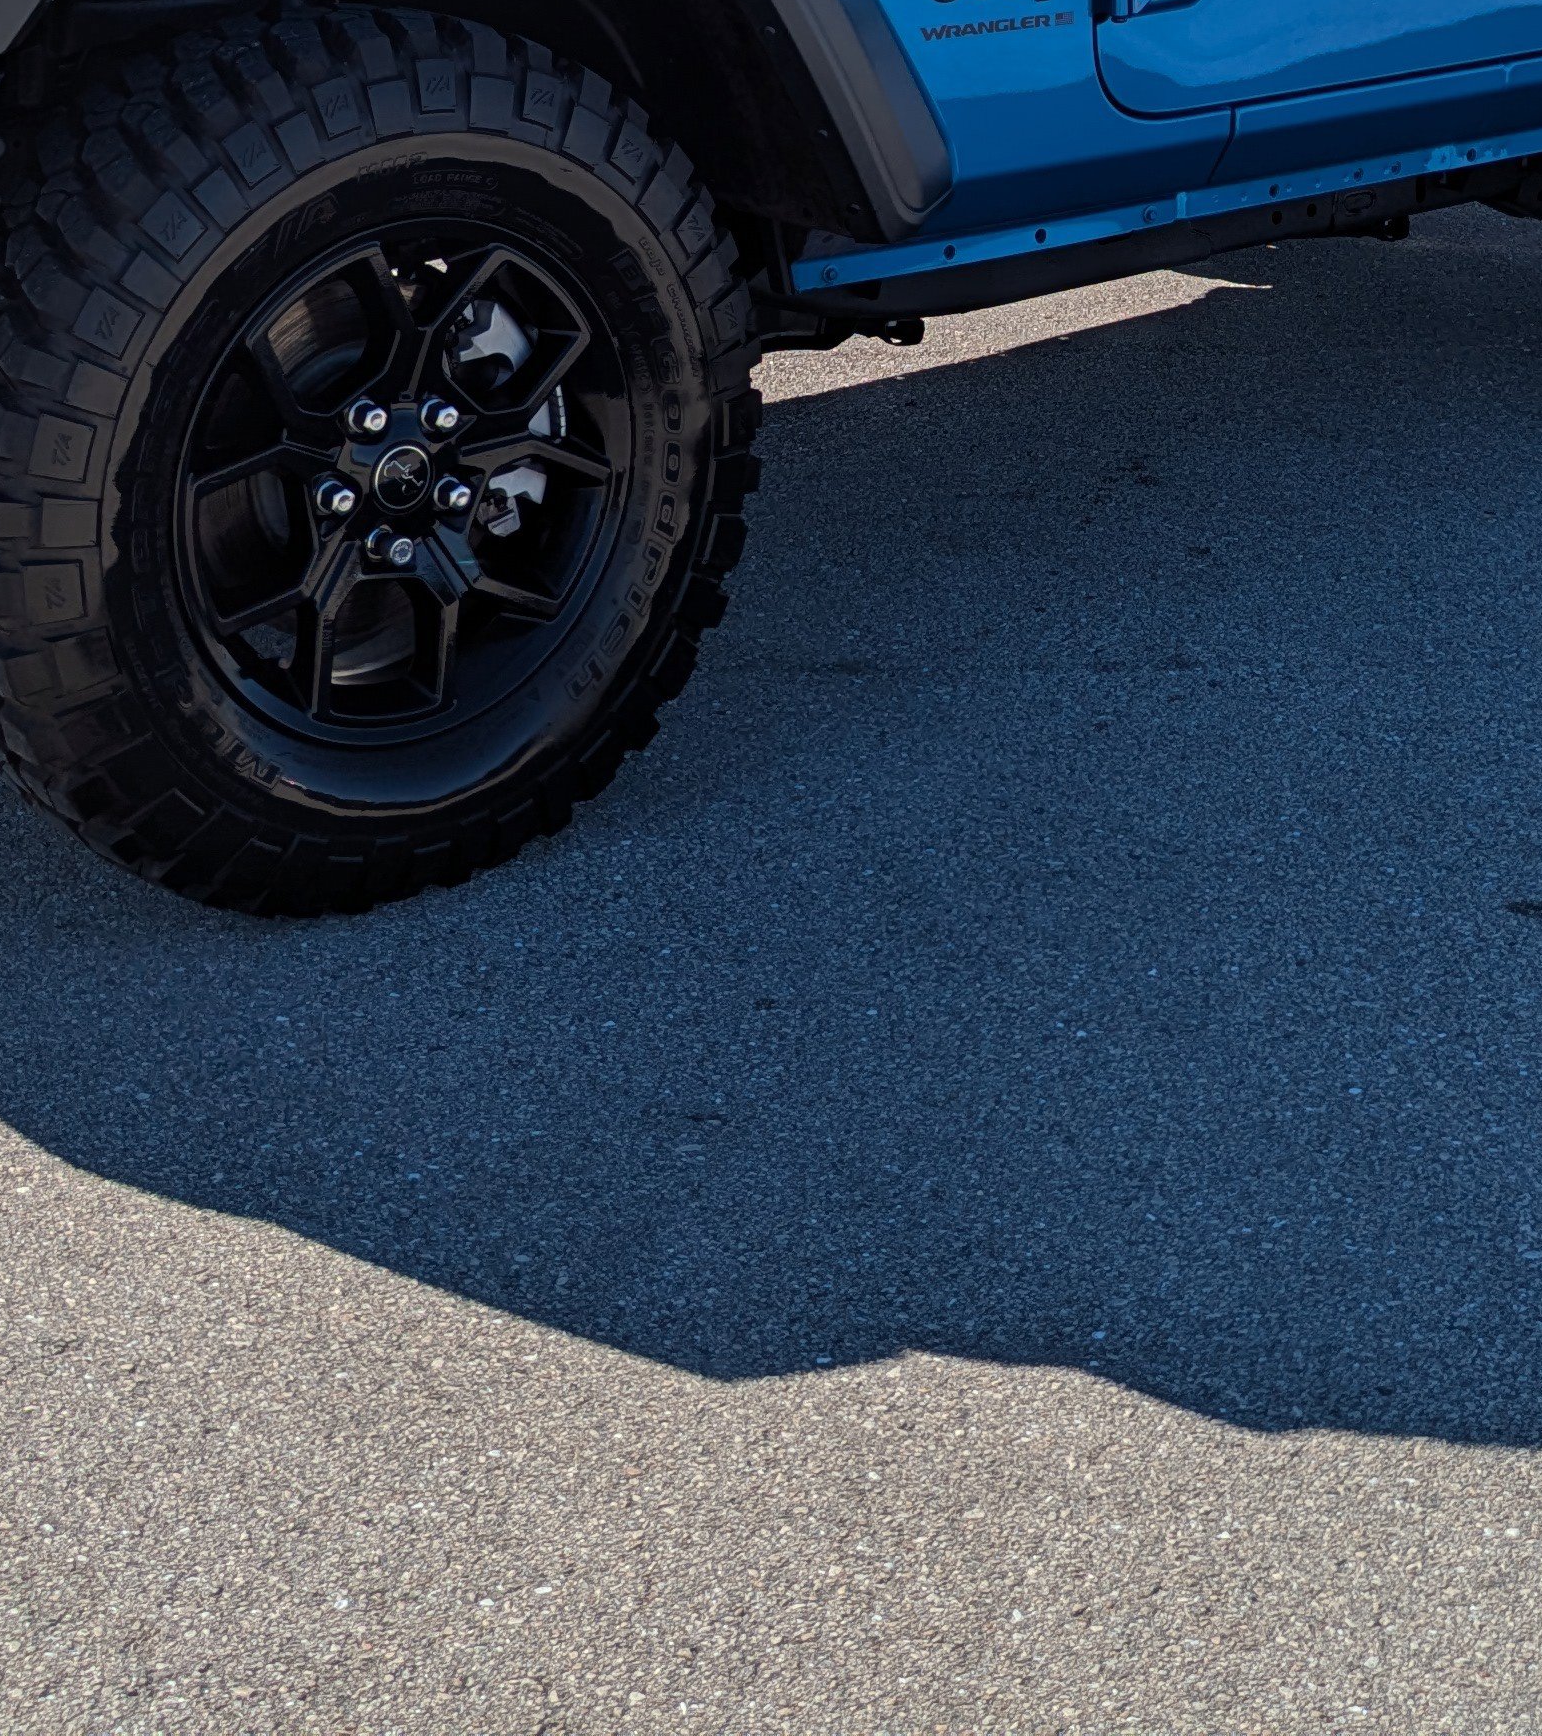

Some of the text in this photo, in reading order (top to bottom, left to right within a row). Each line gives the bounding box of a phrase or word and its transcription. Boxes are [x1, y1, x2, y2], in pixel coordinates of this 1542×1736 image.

[920, 14, 1051, 42] WRANGLER
[425, 74, 451, 95] T/A
[563, 248, 685, 701] BFGoodrich
